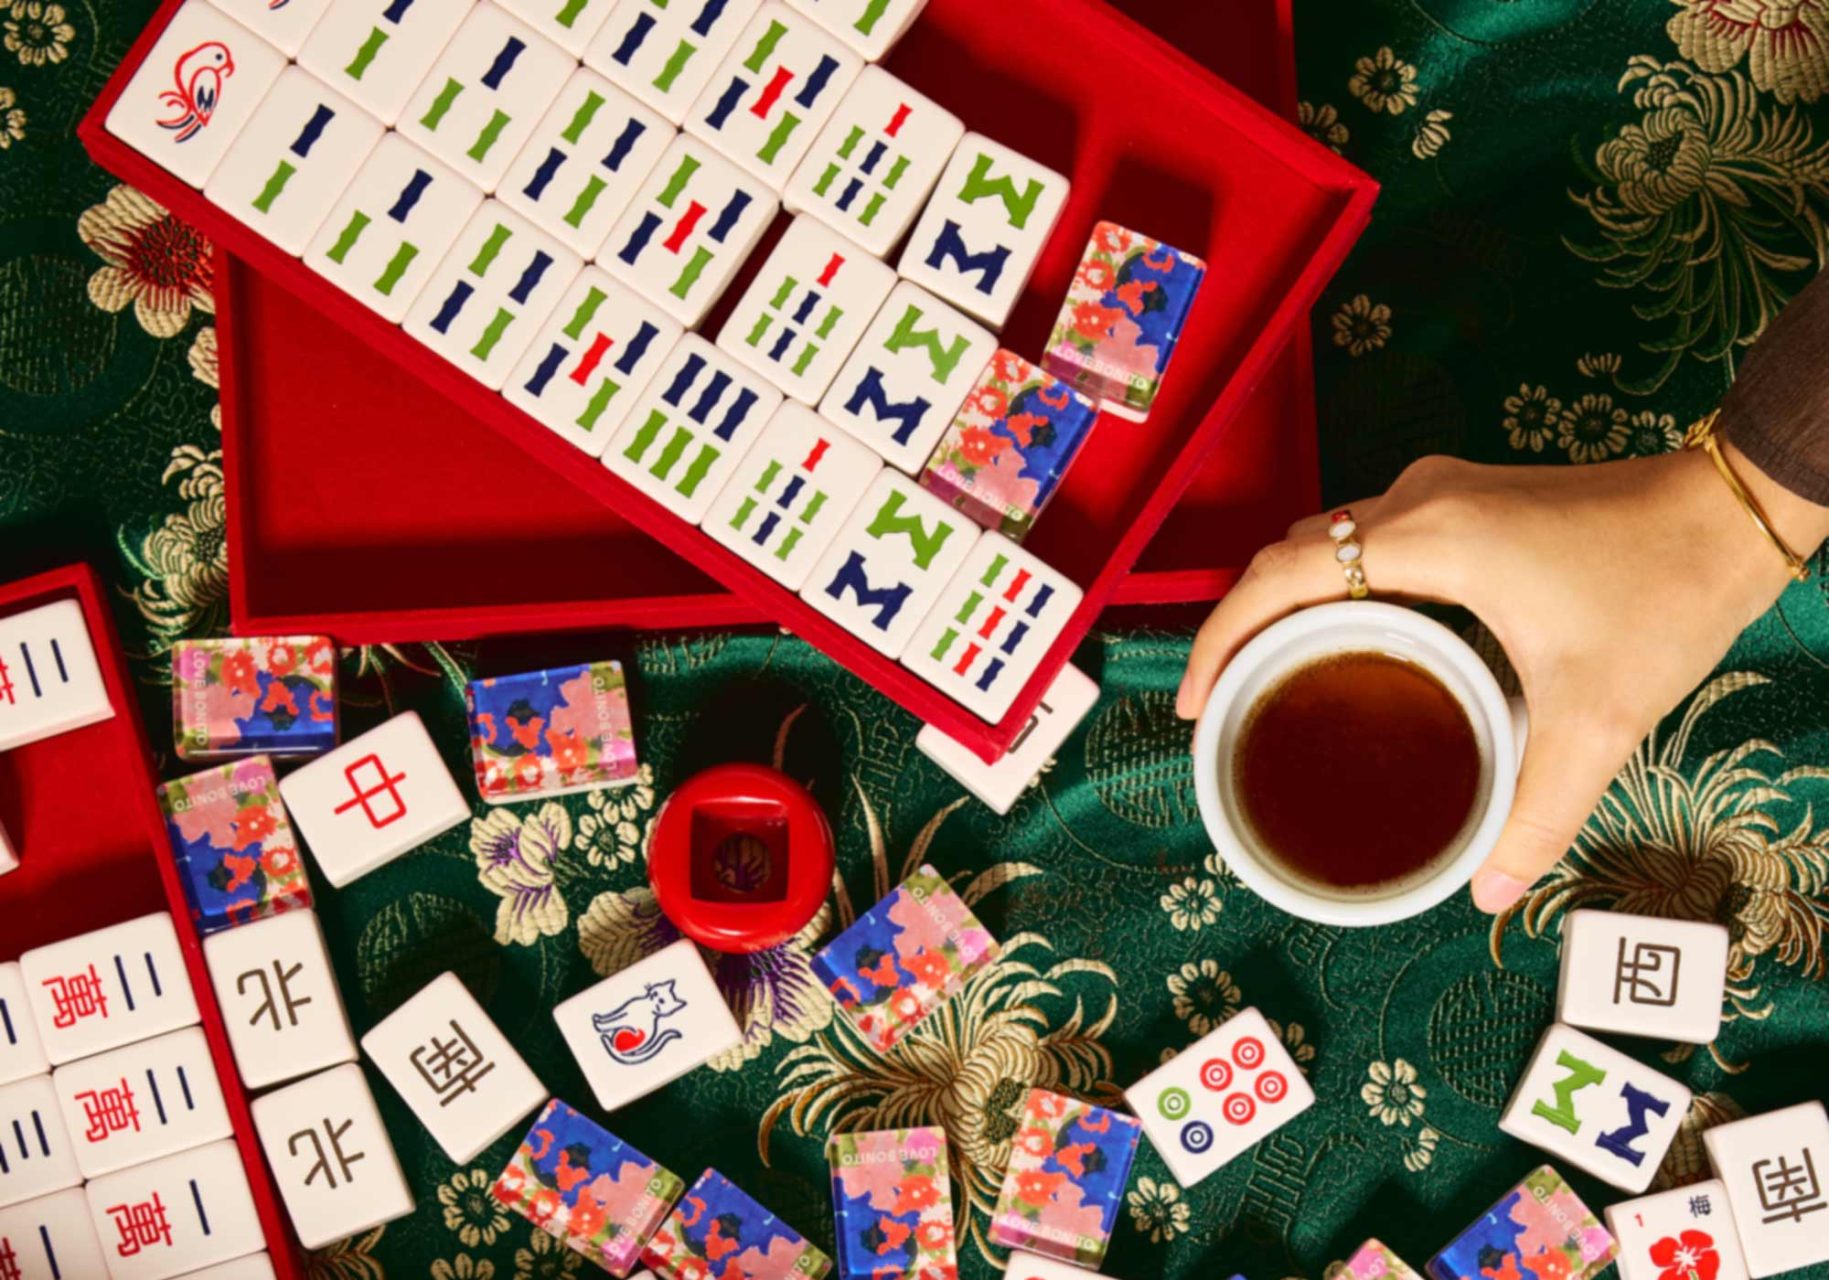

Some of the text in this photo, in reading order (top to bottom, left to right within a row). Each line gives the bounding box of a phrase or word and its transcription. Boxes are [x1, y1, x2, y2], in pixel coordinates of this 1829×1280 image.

[0, 638, 68, 705] 二
[333, 753, 406, 829] 中
[912, 887, 953, 931] BONITO
[236, 959, 312, 1031] 北
[1613, 936, 1681, 1007] 西
[409, 1019, 495, 1108] 南
[287, 1117, 365, 1189] 北
[842, 1151, 896, 1164] BONITO
[1751, 1147, 1829, 1224] 南
[626, 1178, 661, 1225] BONITO
[1533, 1186, 1574, 1230] BONITO
[1635, 1213, 1643, 1227] 1
